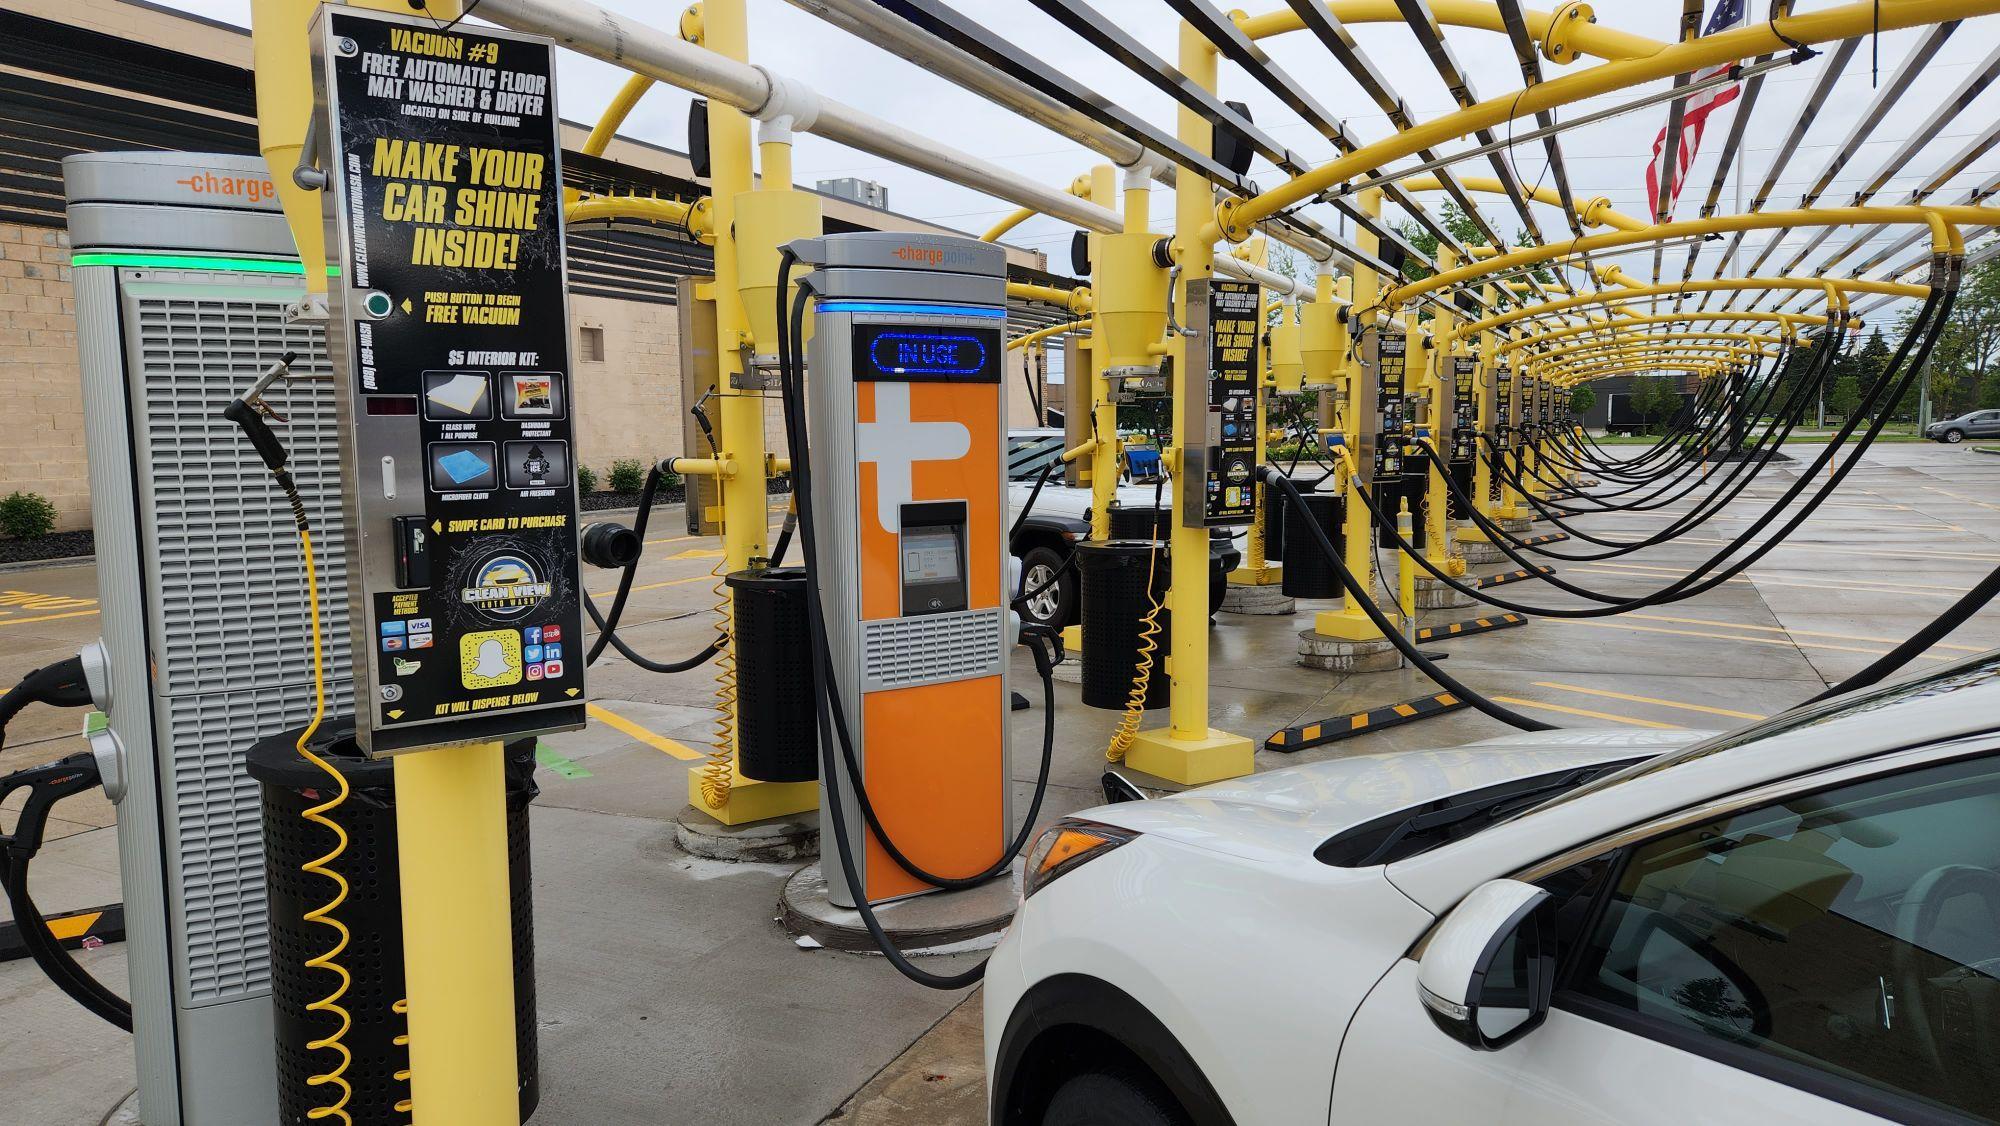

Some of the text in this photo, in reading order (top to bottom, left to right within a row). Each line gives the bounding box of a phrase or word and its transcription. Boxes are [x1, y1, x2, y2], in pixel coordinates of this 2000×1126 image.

[391, 28, 499, 65] VACUUM #9
[362, 52, 547, 96] FREE AUTOMATIC FLOOR
[367, 75, 544, 116] MAT WASHER & DRYER
[400, 103, 521, 128] LOCATED ON SIDE OF BUILDING
[372, 137, 544, 190] MAKE YOUR
[176, 172, 276, 202] charge
[382, 182, 541, 231] CAR SHINE
[411, 227, 520, 271] INSIDE!
[424, 291, 521, 307] PUSH BUTTON TO BEGIN
[426, 305, 520, 326] FREE VACUUM
[448, 350, 539, 366] $5 INTERIOR KIT:
[448, 515, 566, 533] SWIPE CARD TO PURCHASE
[464, 584, 547, 601] CLEAN VIEW
[481, 597, 535, 608] AUTO WASH
[435, 692, 538, 715] KIT WILL DISPENSE BELOW
